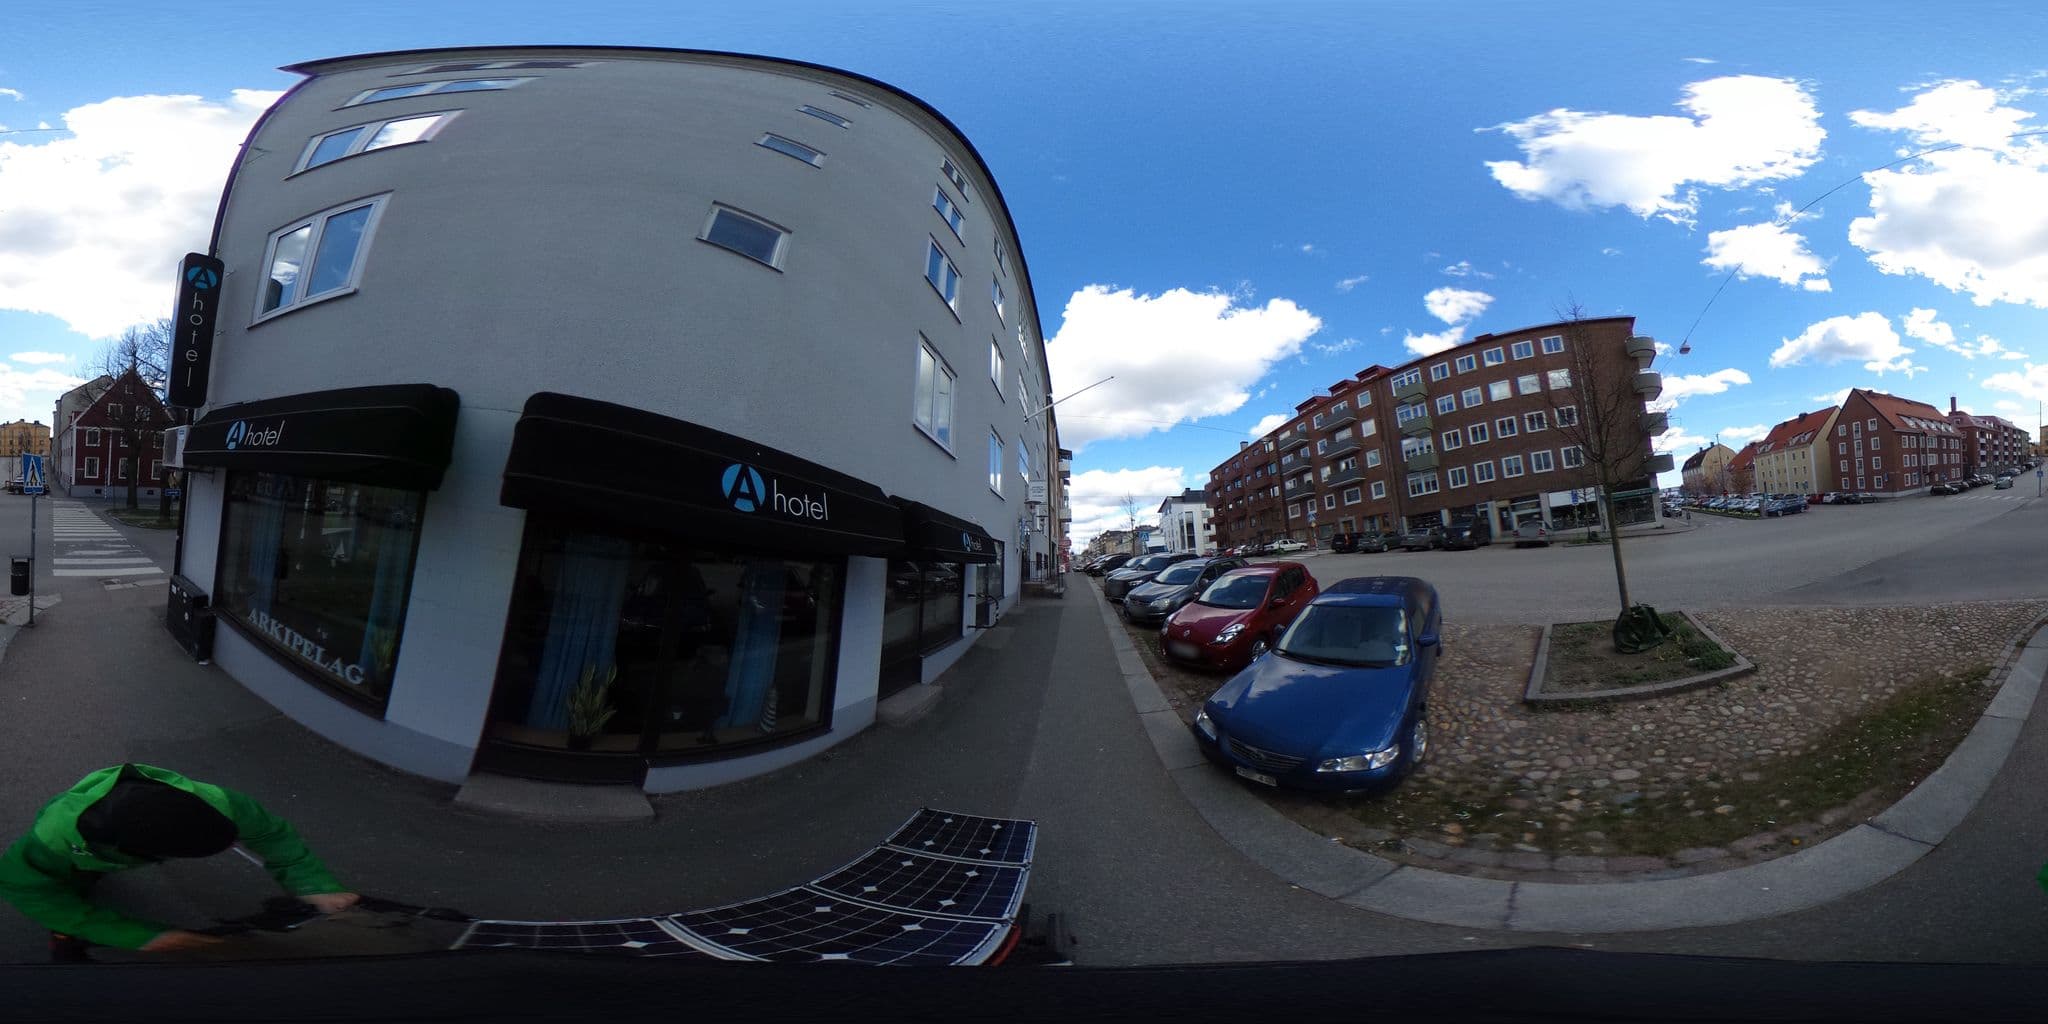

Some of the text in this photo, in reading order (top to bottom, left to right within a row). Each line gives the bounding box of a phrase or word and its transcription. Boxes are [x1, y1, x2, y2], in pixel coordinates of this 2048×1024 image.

[186, 292, 204, 388] hotel
[244, 420, 285, 446] hotel
[774, 479, 829, 521] hotel
[247, 607, 364, 684] ARKIPELAG
